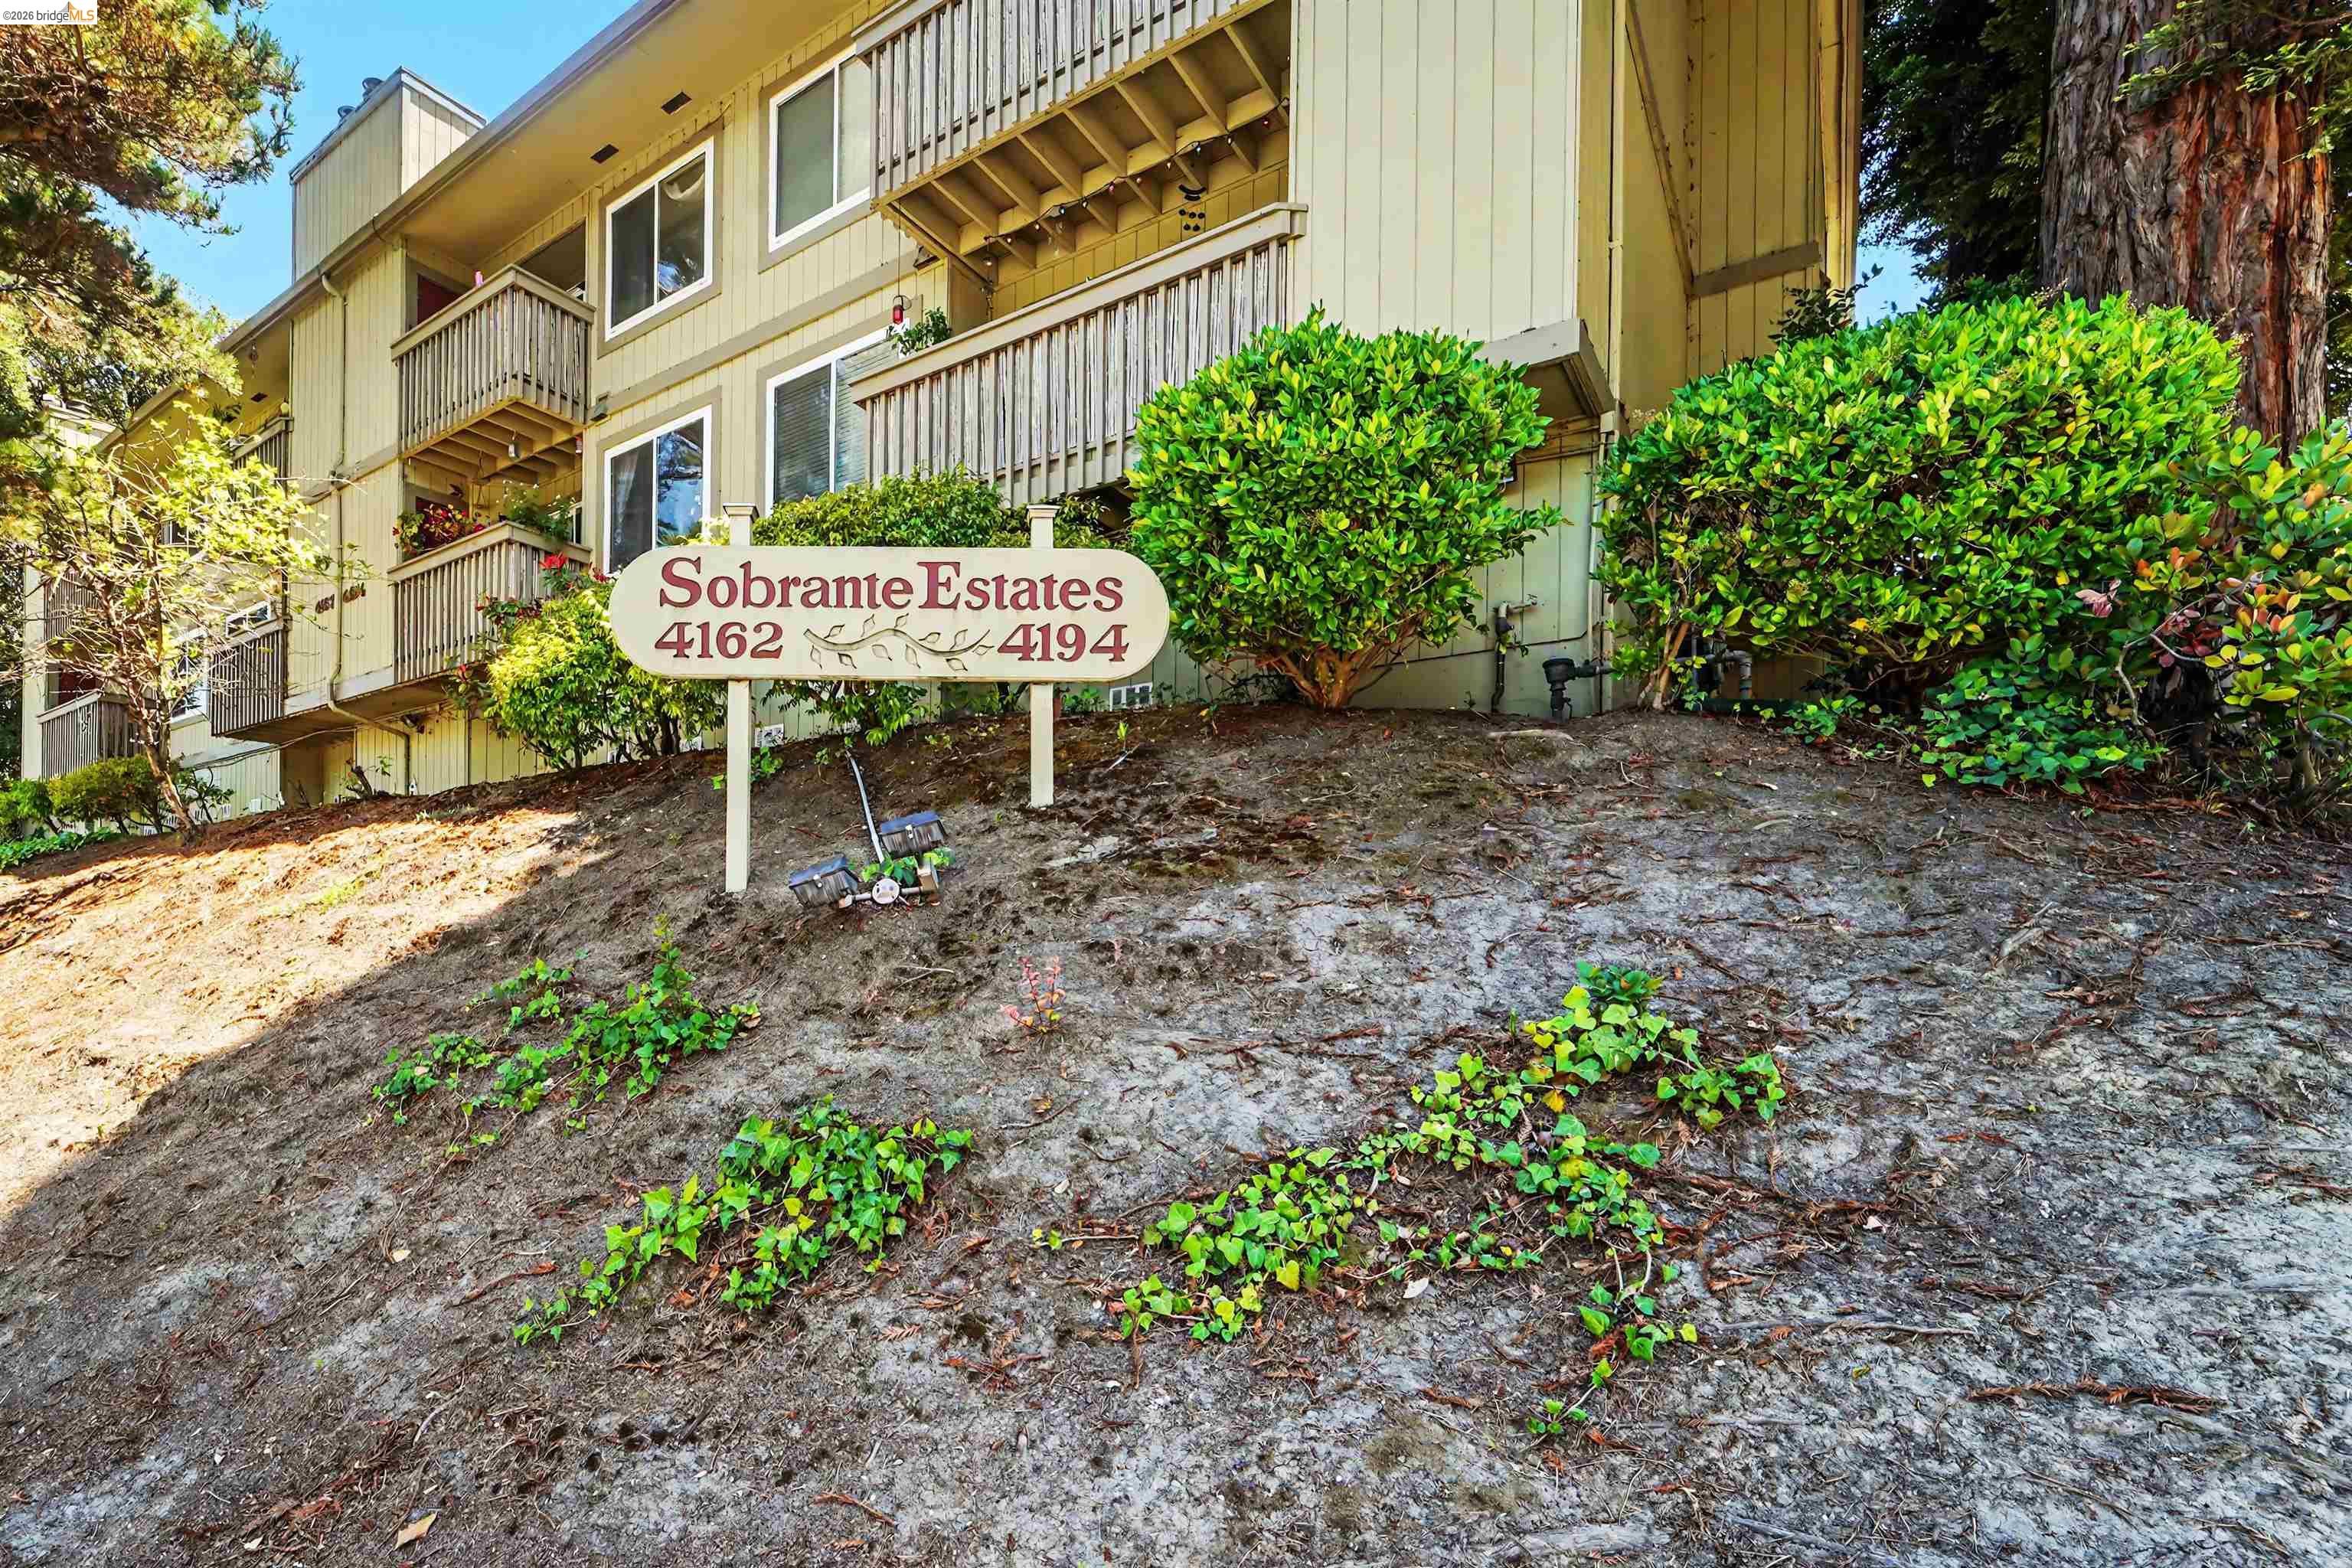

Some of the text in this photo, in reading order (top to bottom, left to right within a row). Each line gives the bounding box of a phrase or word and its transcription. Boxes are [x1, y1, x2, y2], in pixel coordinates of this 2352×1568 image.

[659, 557, 1123, 612] Sobrante Estates
[655, 622, 783, 659] 4162
[997, 624, 1129, 662] 4194
